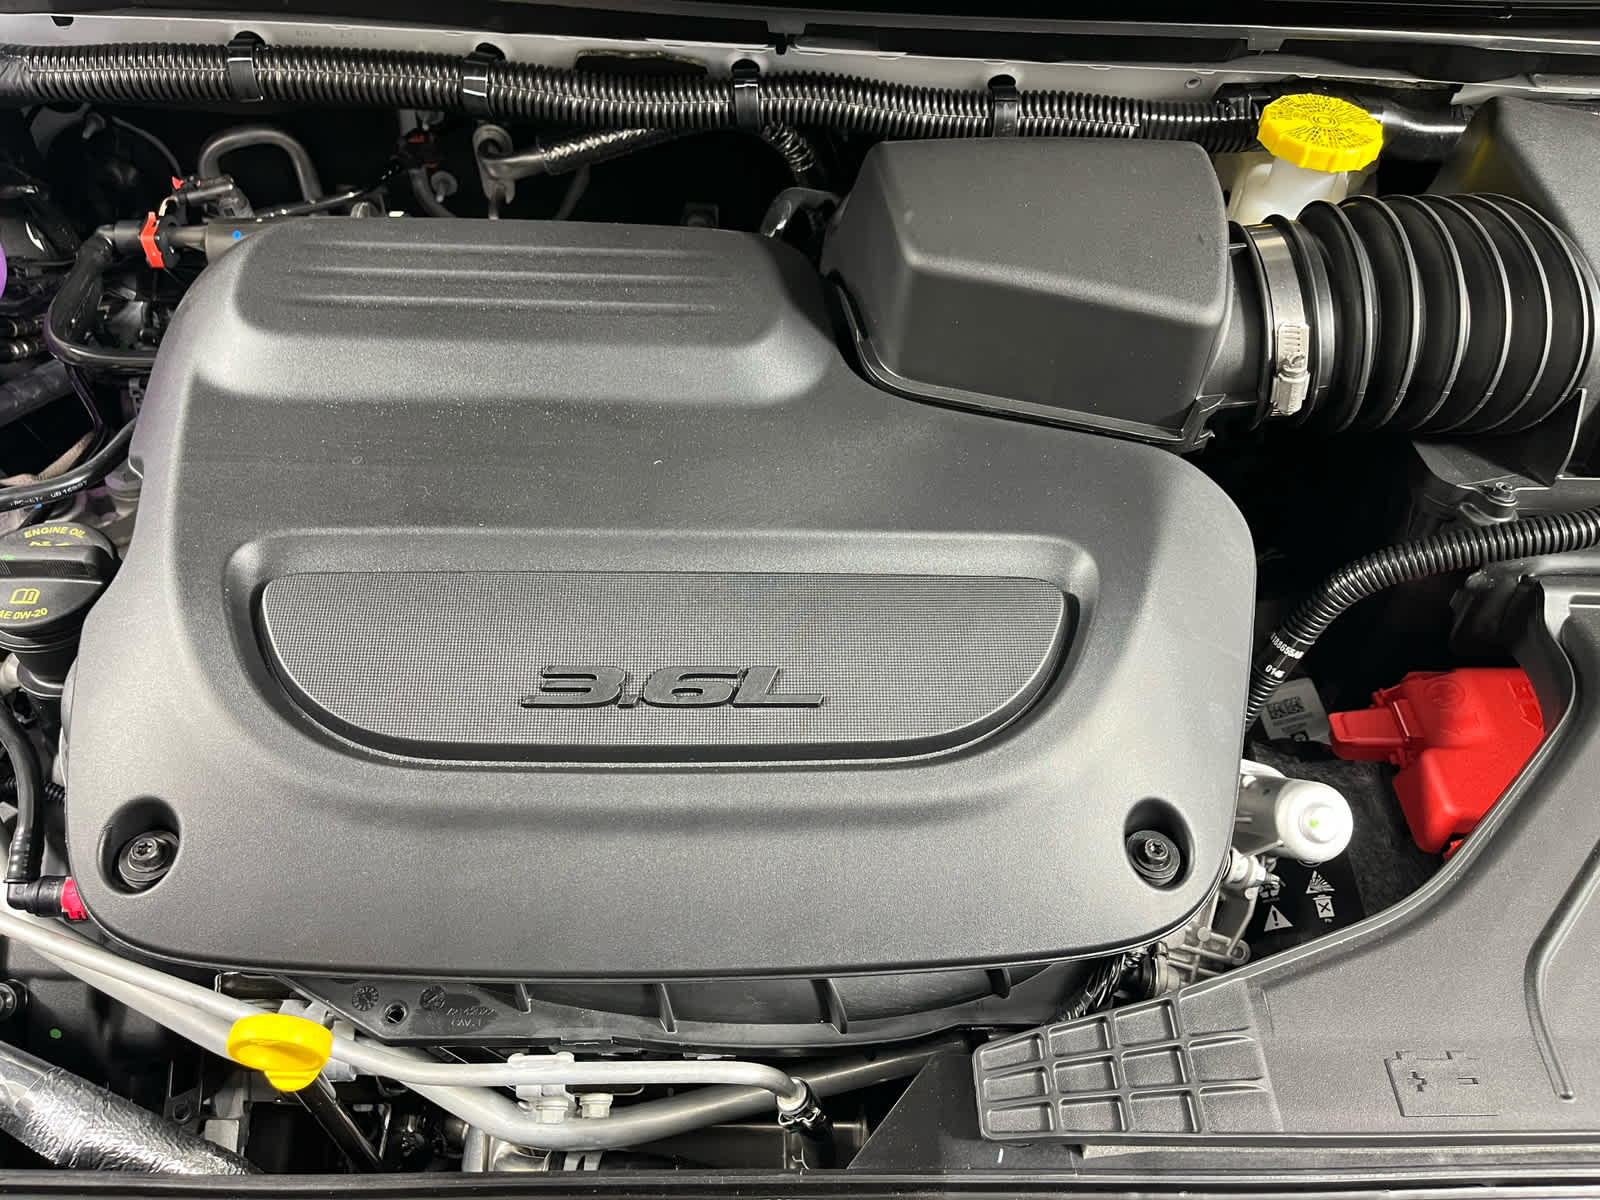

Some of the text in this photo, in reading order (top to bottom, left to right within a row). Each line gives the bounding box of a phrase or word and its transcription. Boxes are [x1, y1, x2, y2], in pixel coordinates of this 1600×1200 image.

[24, 526, 85, 538] ENGINE OIL
[0, 607, 48, 620] AE 0W-20
[521, 665, 824, 708] 3.6L
